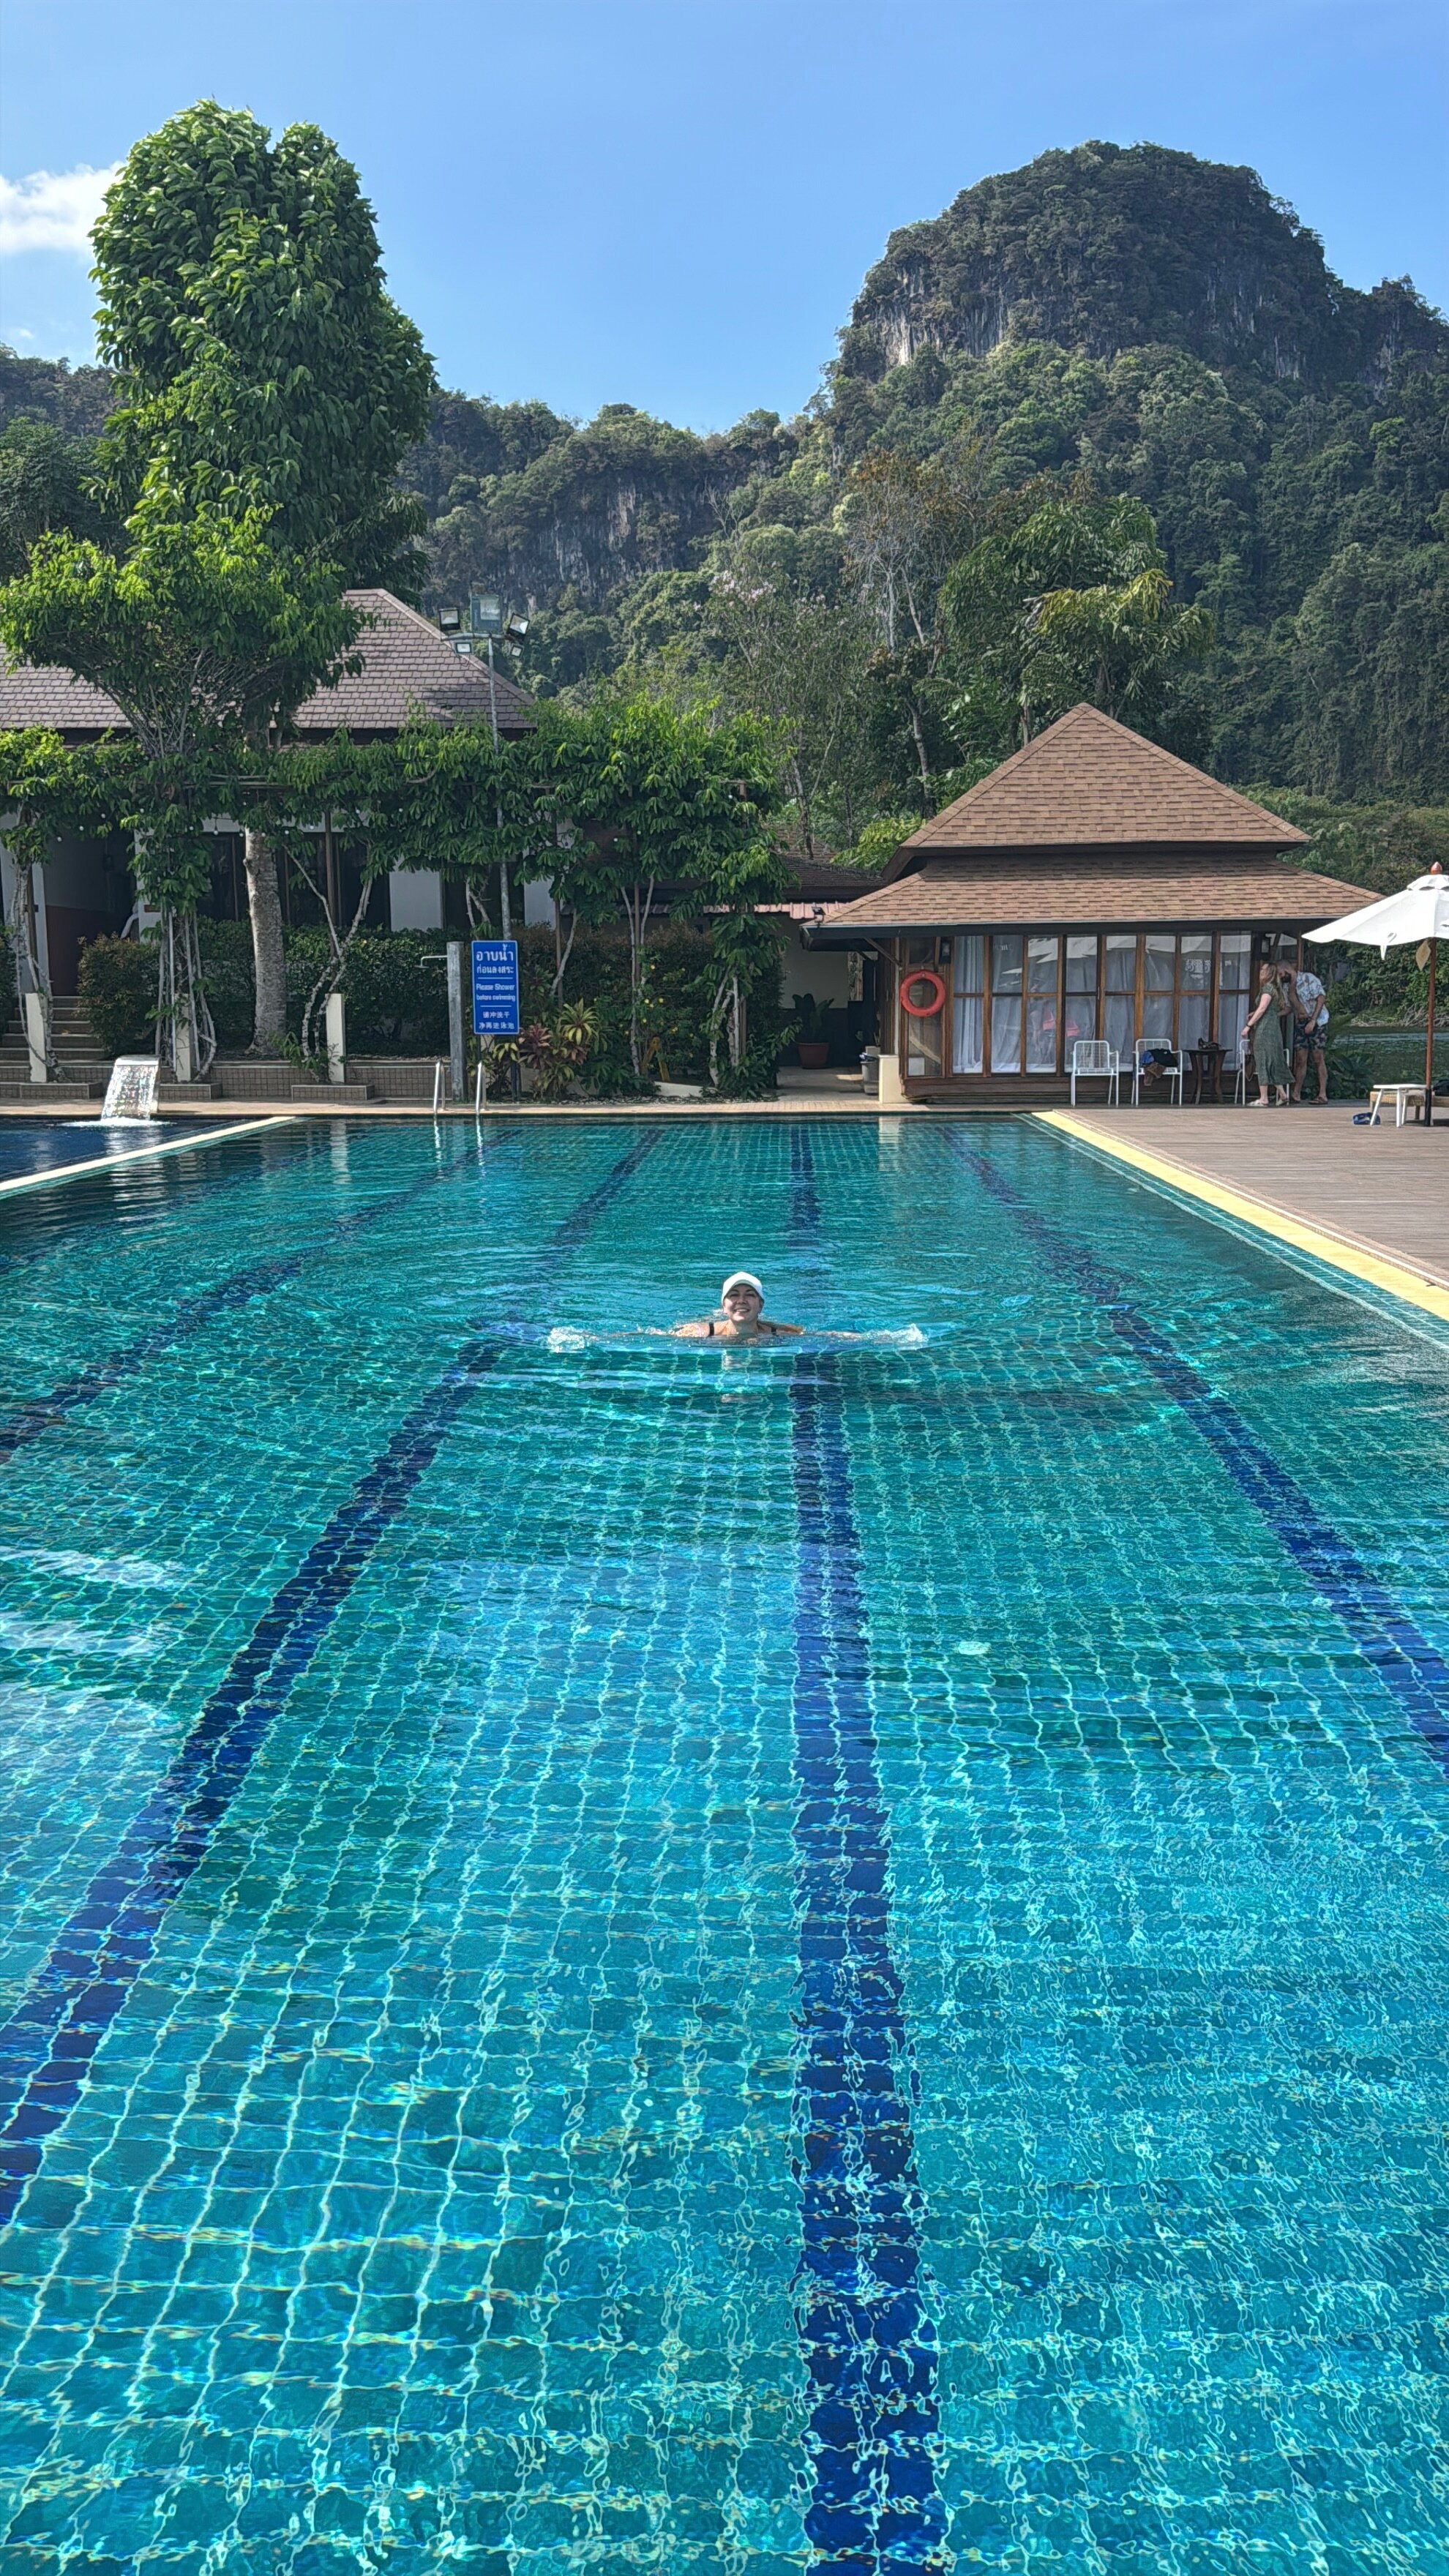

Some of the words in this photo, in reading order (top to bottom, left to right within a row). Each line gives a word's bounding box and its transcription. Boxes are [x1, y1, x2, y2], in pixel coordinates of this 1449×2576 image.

[476, 943, 514, 961] อาบน้ำ
[476, 964, 514, 974] ก่อนลงสระ
[493, 994, 516, 1003] swimming
